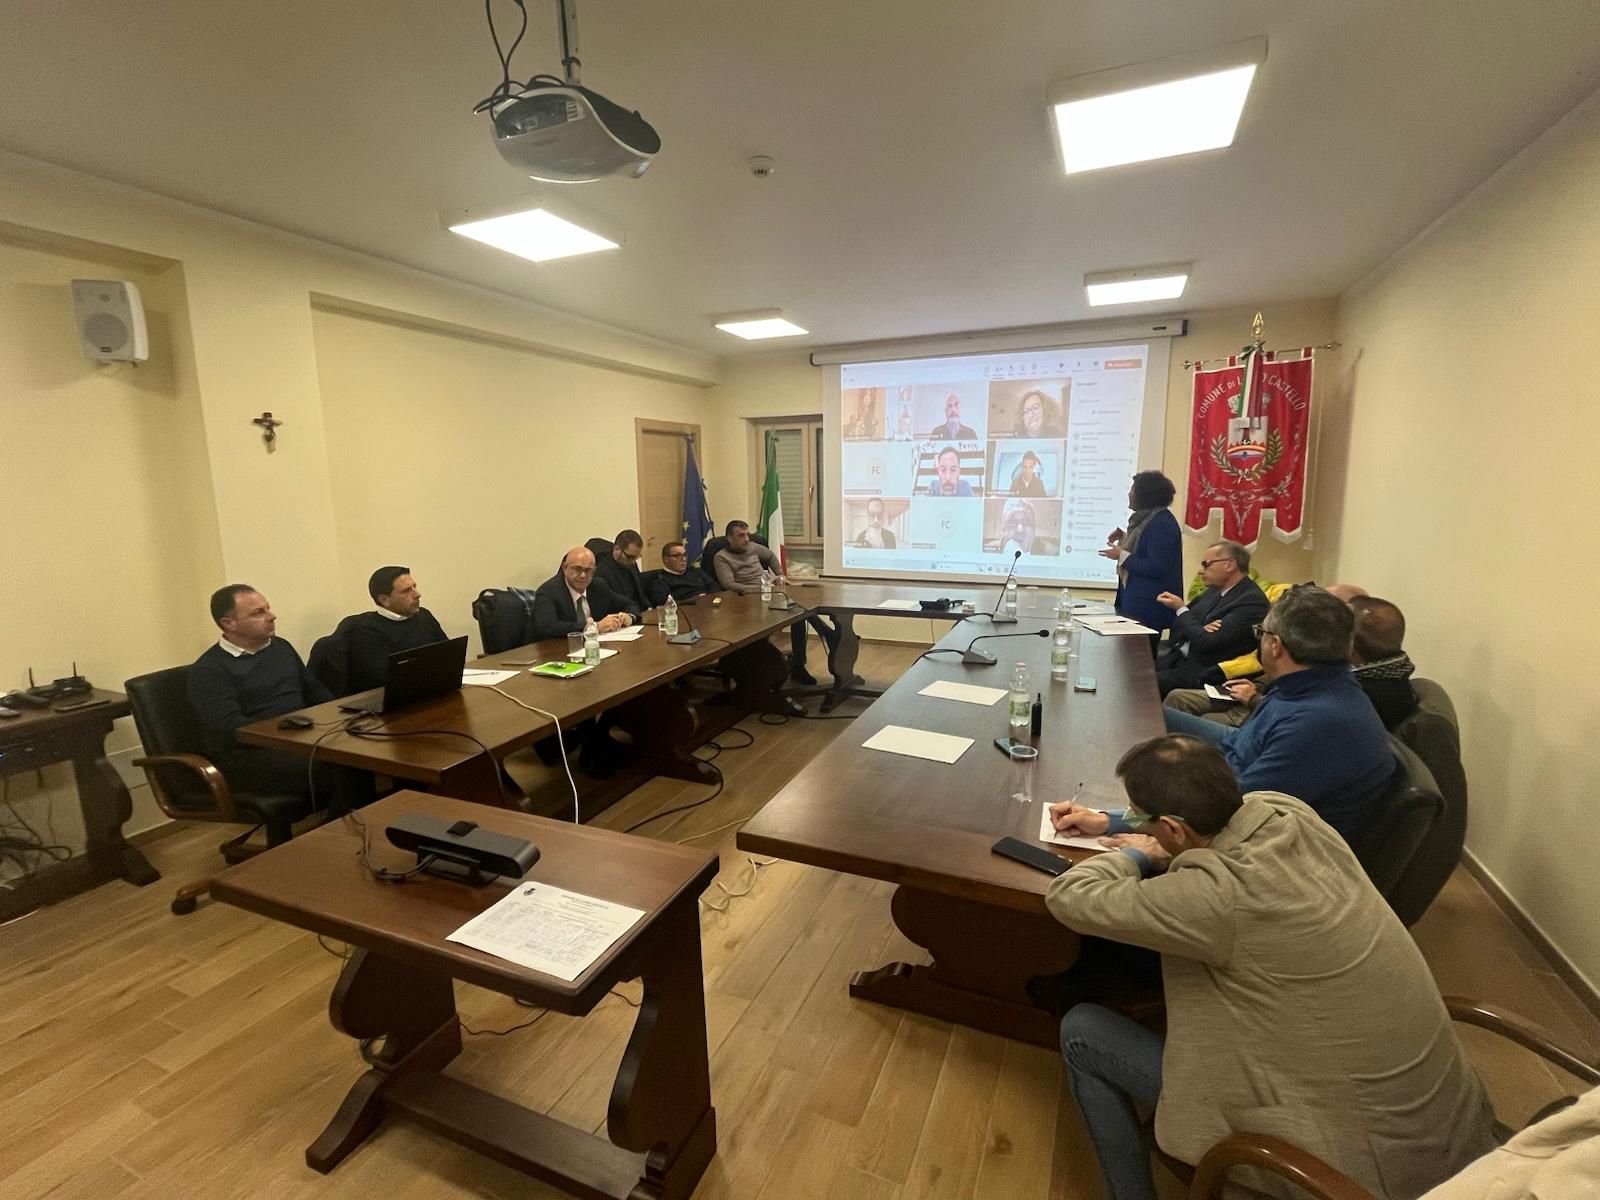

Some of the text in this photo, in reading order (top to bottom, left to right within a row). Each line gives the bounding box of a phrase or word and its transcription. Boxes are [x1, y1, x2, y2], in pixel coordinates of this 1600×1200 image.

[1198, 375, 1306, 419] COMUNE DI CASTELLO
[872, 466, 881, 474] FC
[941, 520, 951, 529] FC
